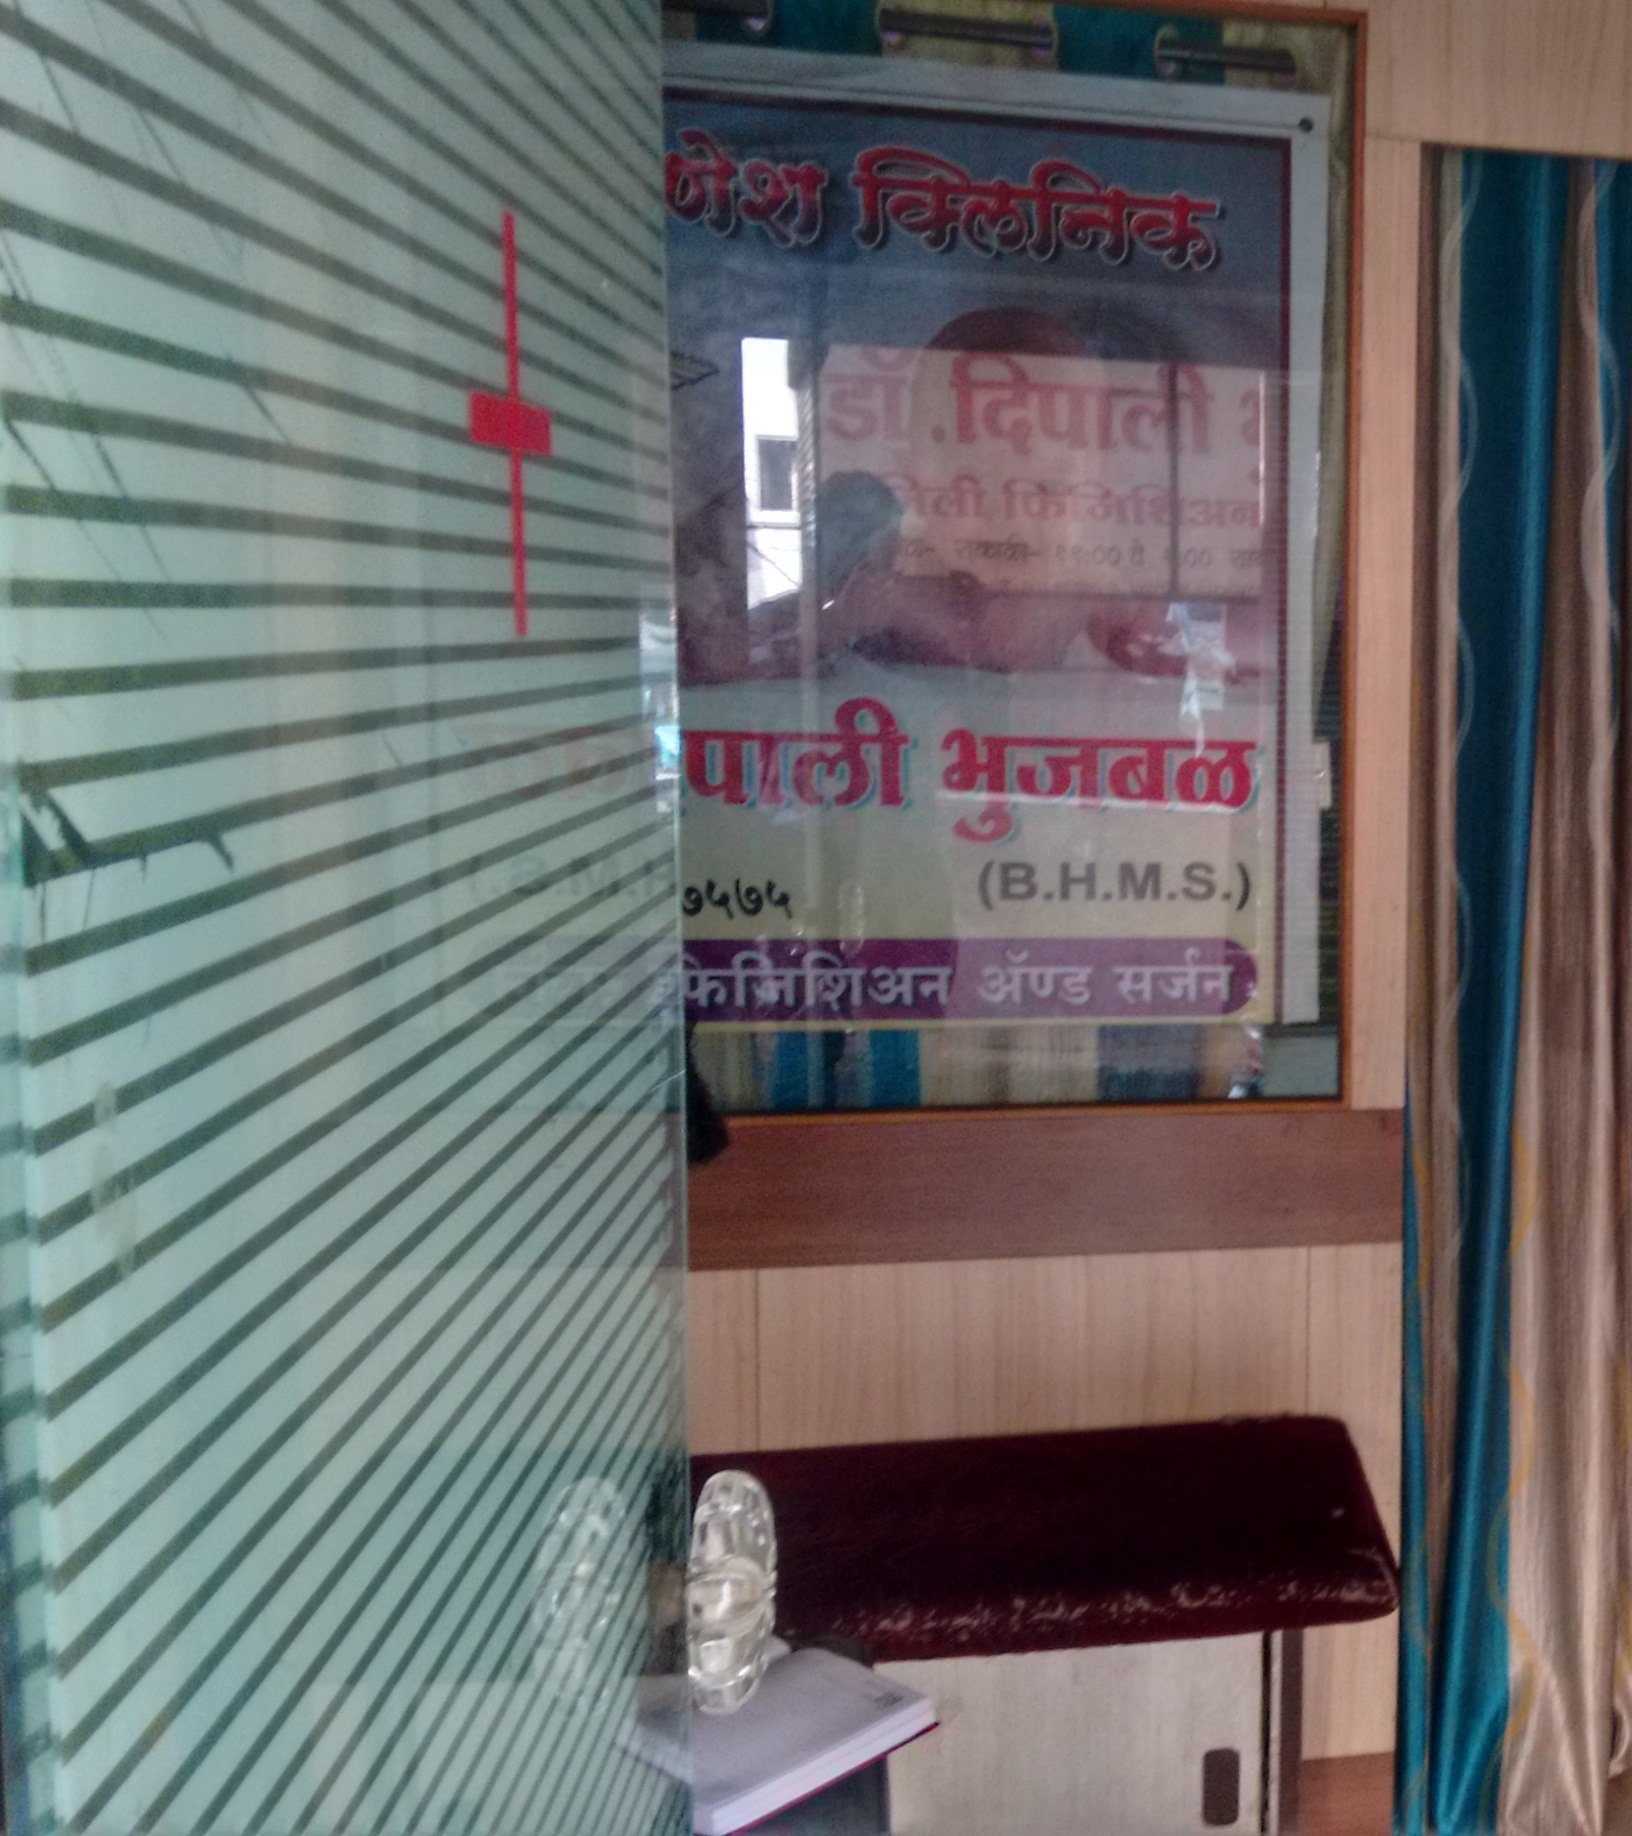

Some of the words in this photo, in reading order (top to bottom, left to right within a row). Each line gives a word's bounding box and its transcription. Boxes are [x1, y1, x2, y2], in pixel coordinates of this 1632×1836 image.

[853, 144, 1224, 270] क्लिनिक
[939, 726, 1262, 844] भुजबळ
[978, 860, 1251, 912] (B.H.M.S.)
[1112, 948, 1234, 1004] सर्जन
